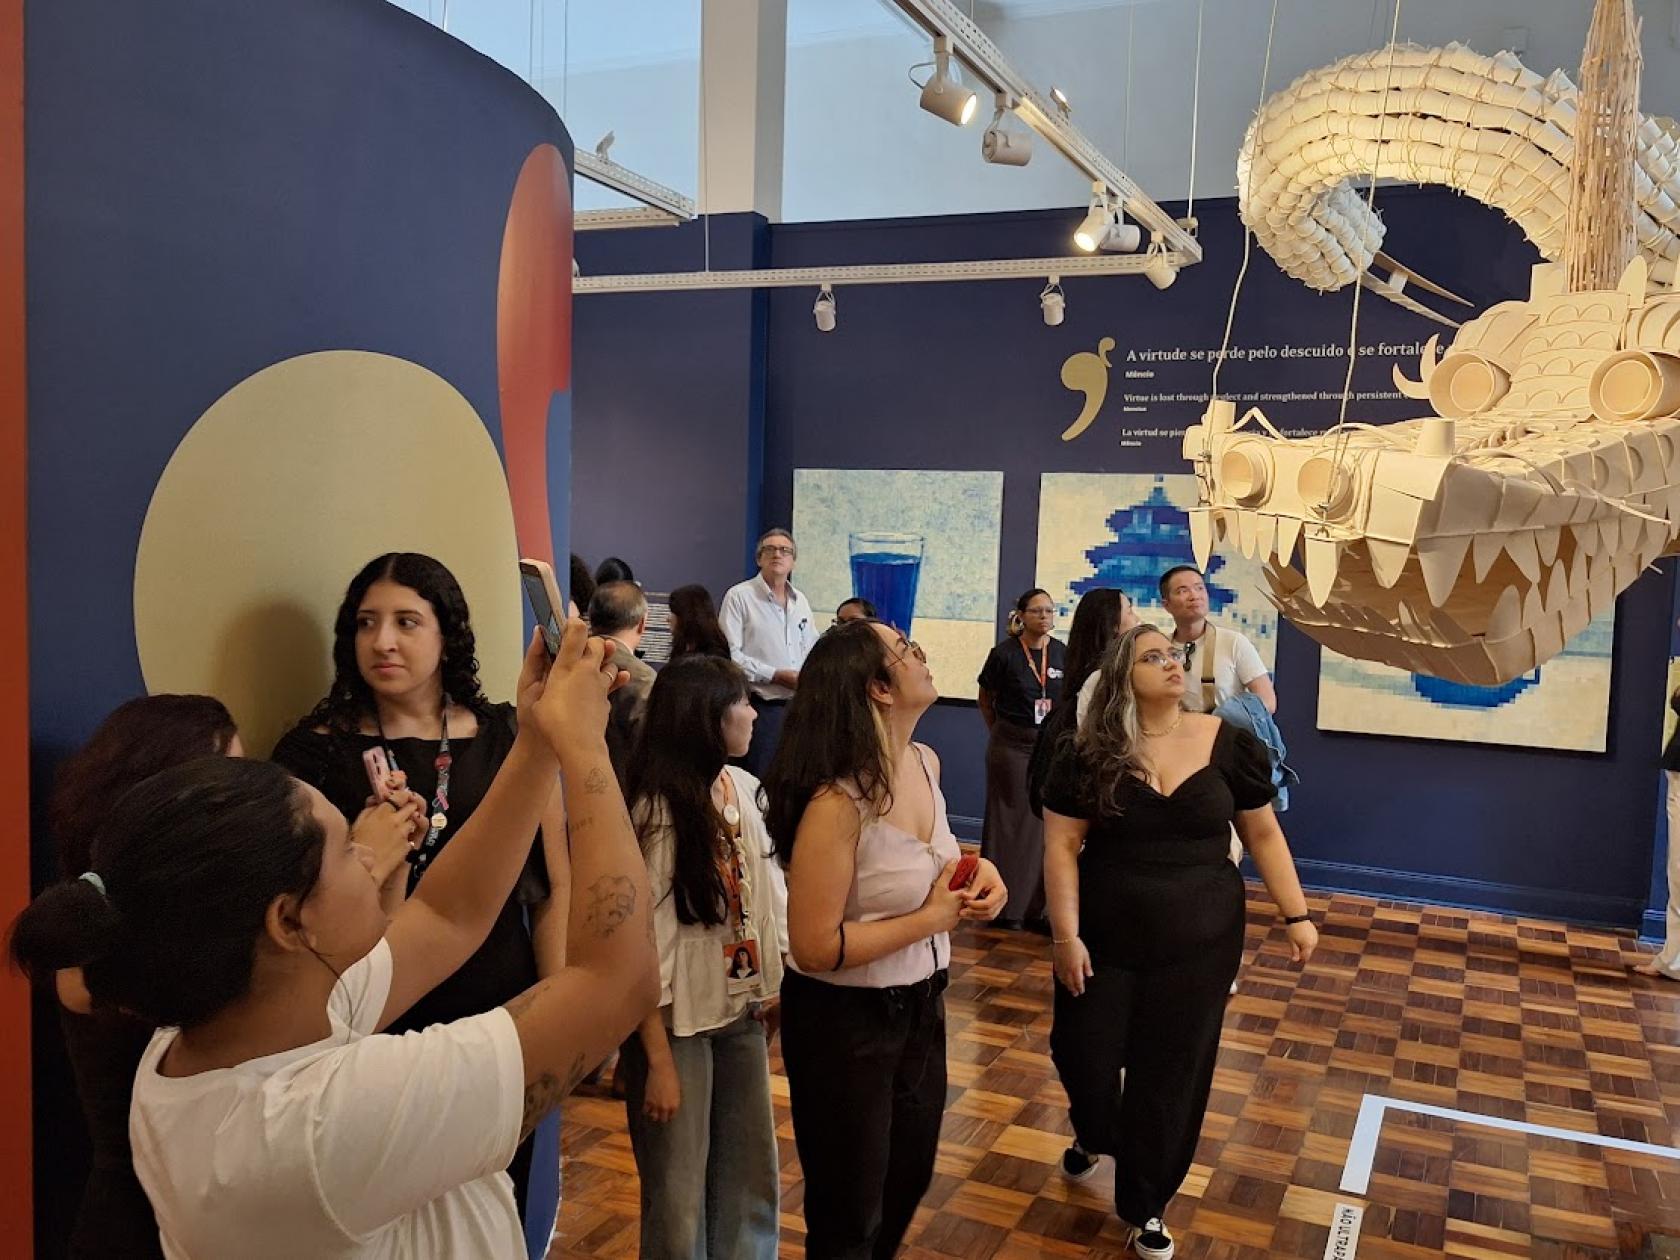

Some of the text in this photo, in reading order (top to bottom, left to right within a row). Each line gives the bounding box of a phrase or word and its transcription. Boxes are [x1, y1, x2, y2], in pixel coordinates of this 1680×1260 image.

[1126, 349, 1137, 361] A
[1139, 347, 1187, 361] virtude
[1190, 350, 1205, 360] se
[1248, 346, 1277, 361] pelo
[1280, 345, 1344, 358] descuido
[1358, 345, 1374, 356] se
[1243, 392, 1259, 401] and
